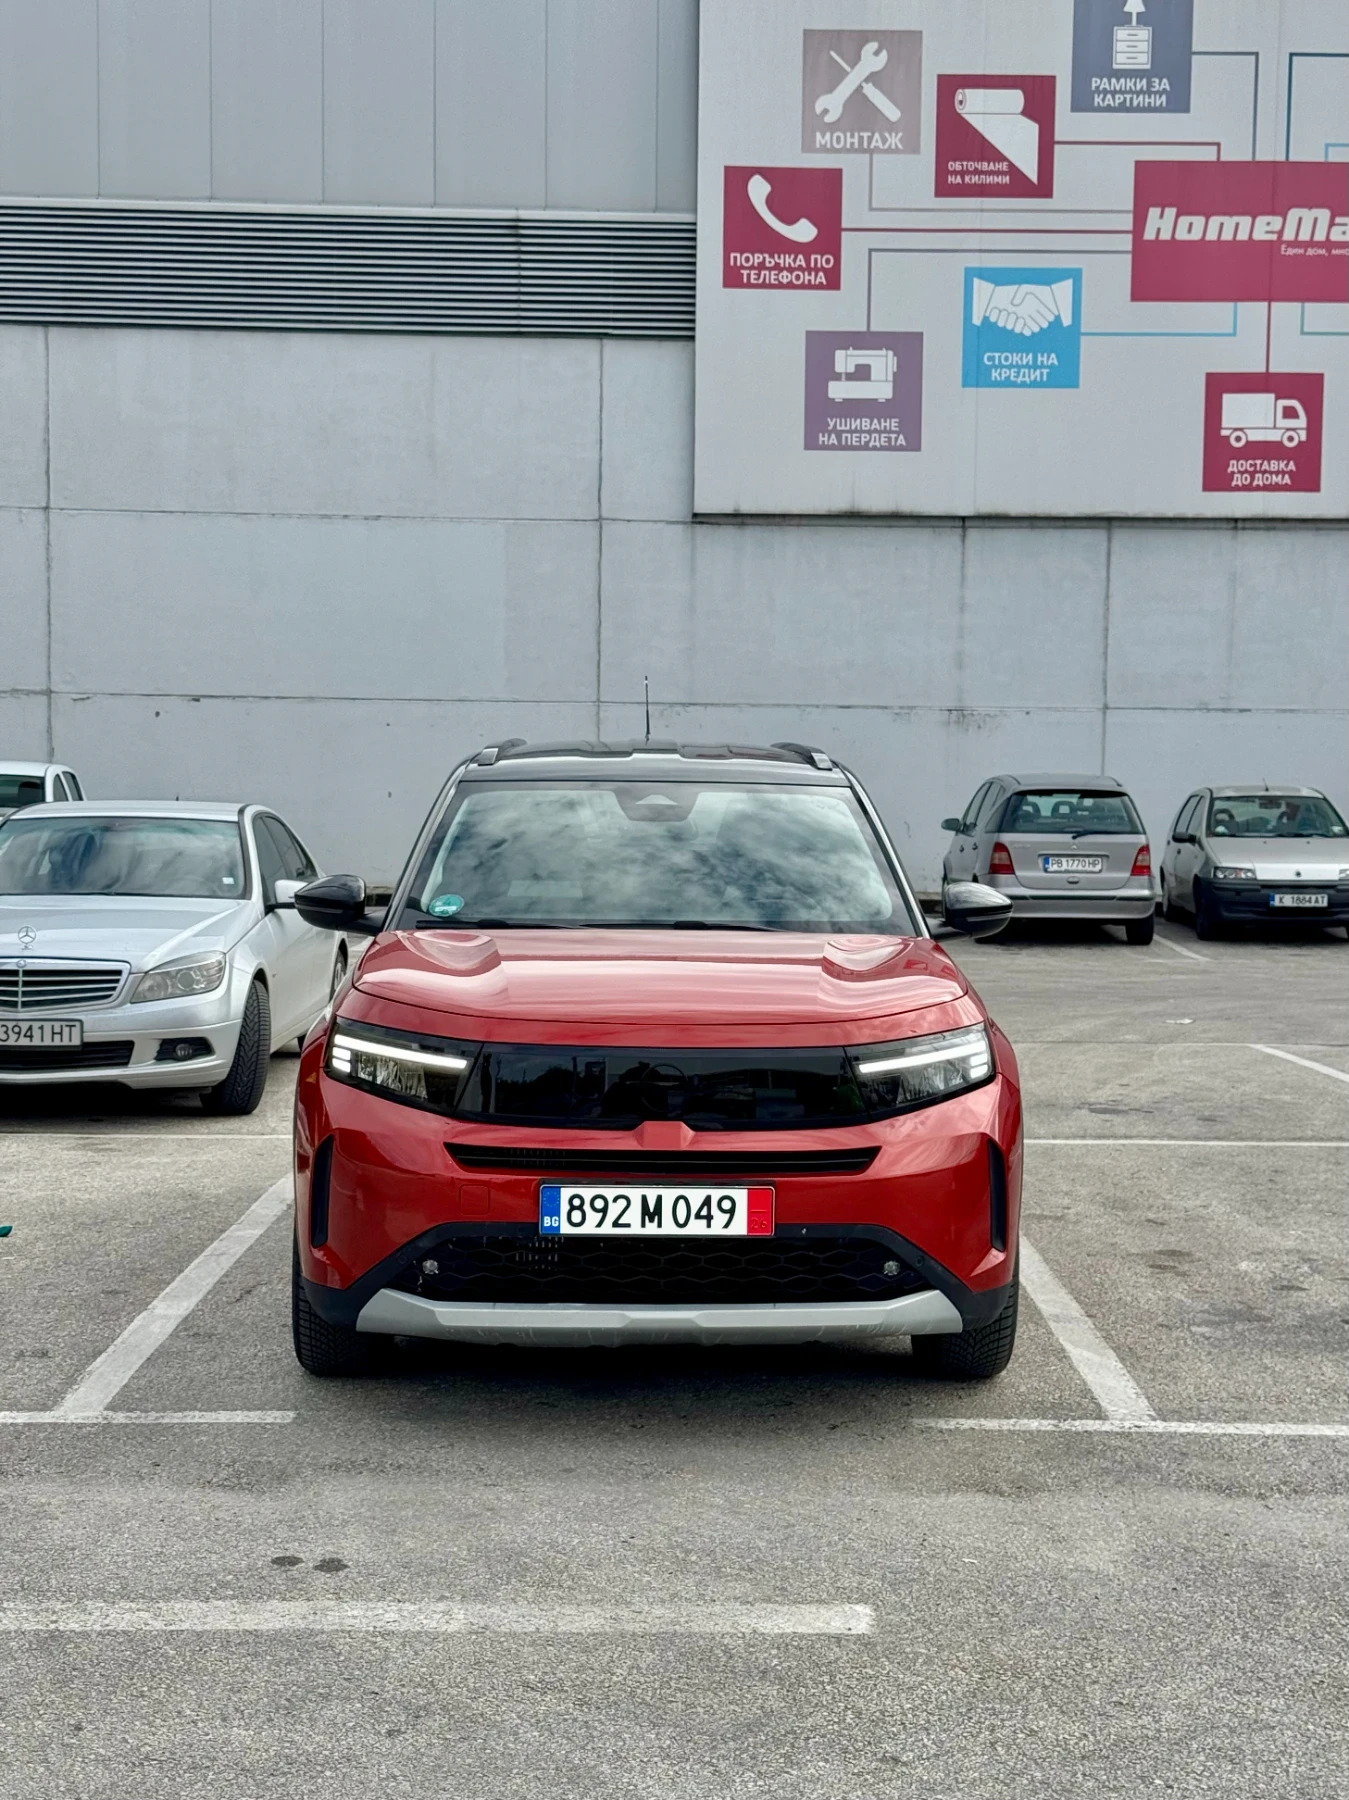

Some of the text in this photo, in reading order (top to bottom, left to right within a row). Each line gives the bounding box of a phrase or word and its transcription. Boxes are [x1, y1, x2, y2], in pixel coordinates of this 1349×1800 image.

[1091, 77, 1170, 92] РАМКИ ЗА
[1094, 94, 1167, 108] КАРТИНИ
[815, 131, 903, 150] МОНТАЖ
[948, 161, 1009, 171] ОБТОЧВАНЕ
[948, 174, 1010, 185] НА КИЛИМИ
[729, 252, 835, 269] ПОРЪЧКА ПО
[740, 269, 827, 286] ТЕЛЕФОНА
[983, 352, 1059, 366] СТОКИ НА
[991, 368, 1050, 384] КРЕДИТ
[827, 418, 900, 432] УШИВАНЕ
[818, 433, 907, 448] НА ПЕРДЕТА
[1227, 460, 1296, 474] ДОСТАВКА
[1231, 473, 1292, 487] ДО ДОМА
[1065, 858, 1087, 868] 1770
[0, 1024, 77, 1042] 3941 HT
[543, 1216, 559, 1227] BG
[566, 1193, 632, 1228] 892
[640, 1194, 663, 1229] M
[671, 1194, 737, 1230] 049
